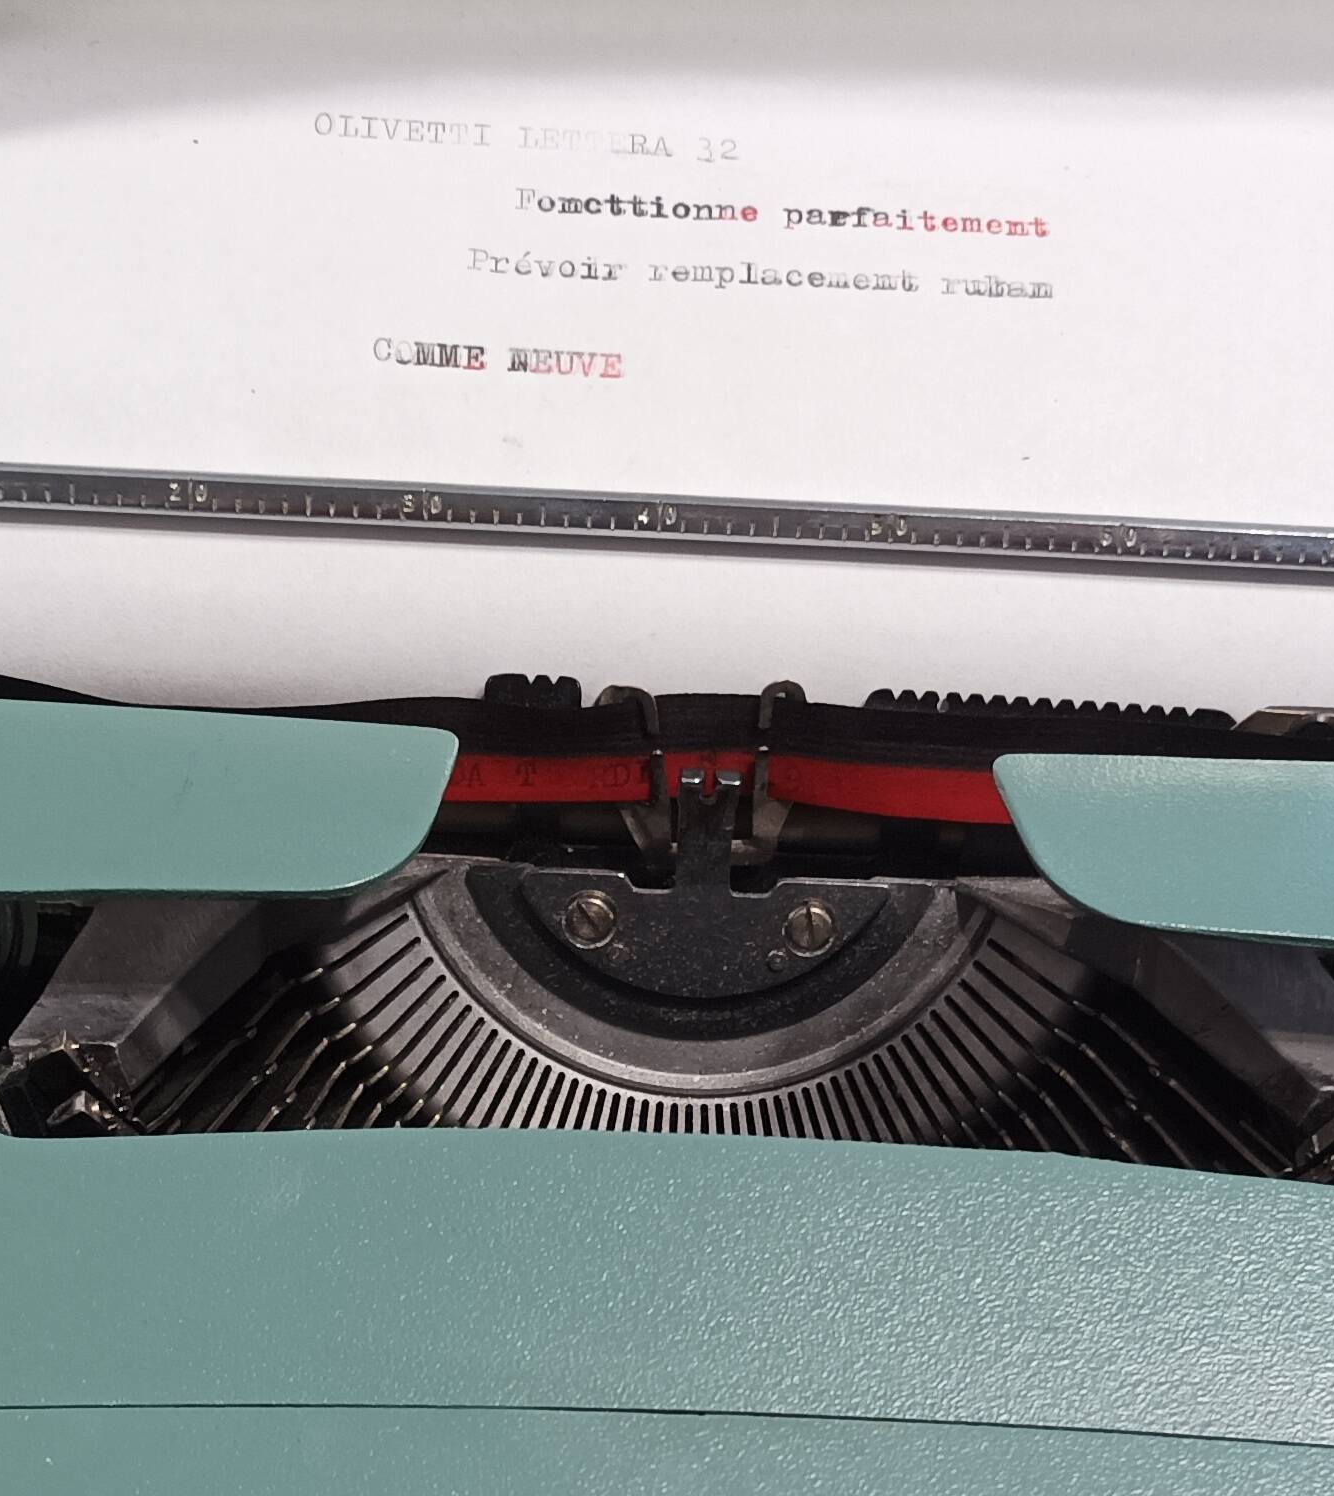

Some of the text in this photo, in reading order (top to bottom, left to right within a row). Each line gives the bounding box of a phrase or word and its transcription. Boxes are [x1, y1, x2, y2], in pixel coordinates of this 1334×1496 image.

[314, 112, 741, 164] OLIVETTI LETTERA 32
[783, 206, 1051, 238] parfaitement
[467, 247, 1054, 300] Prévoir remplacement ruban
[373, 337, 624, 379] COMME NEUVE
